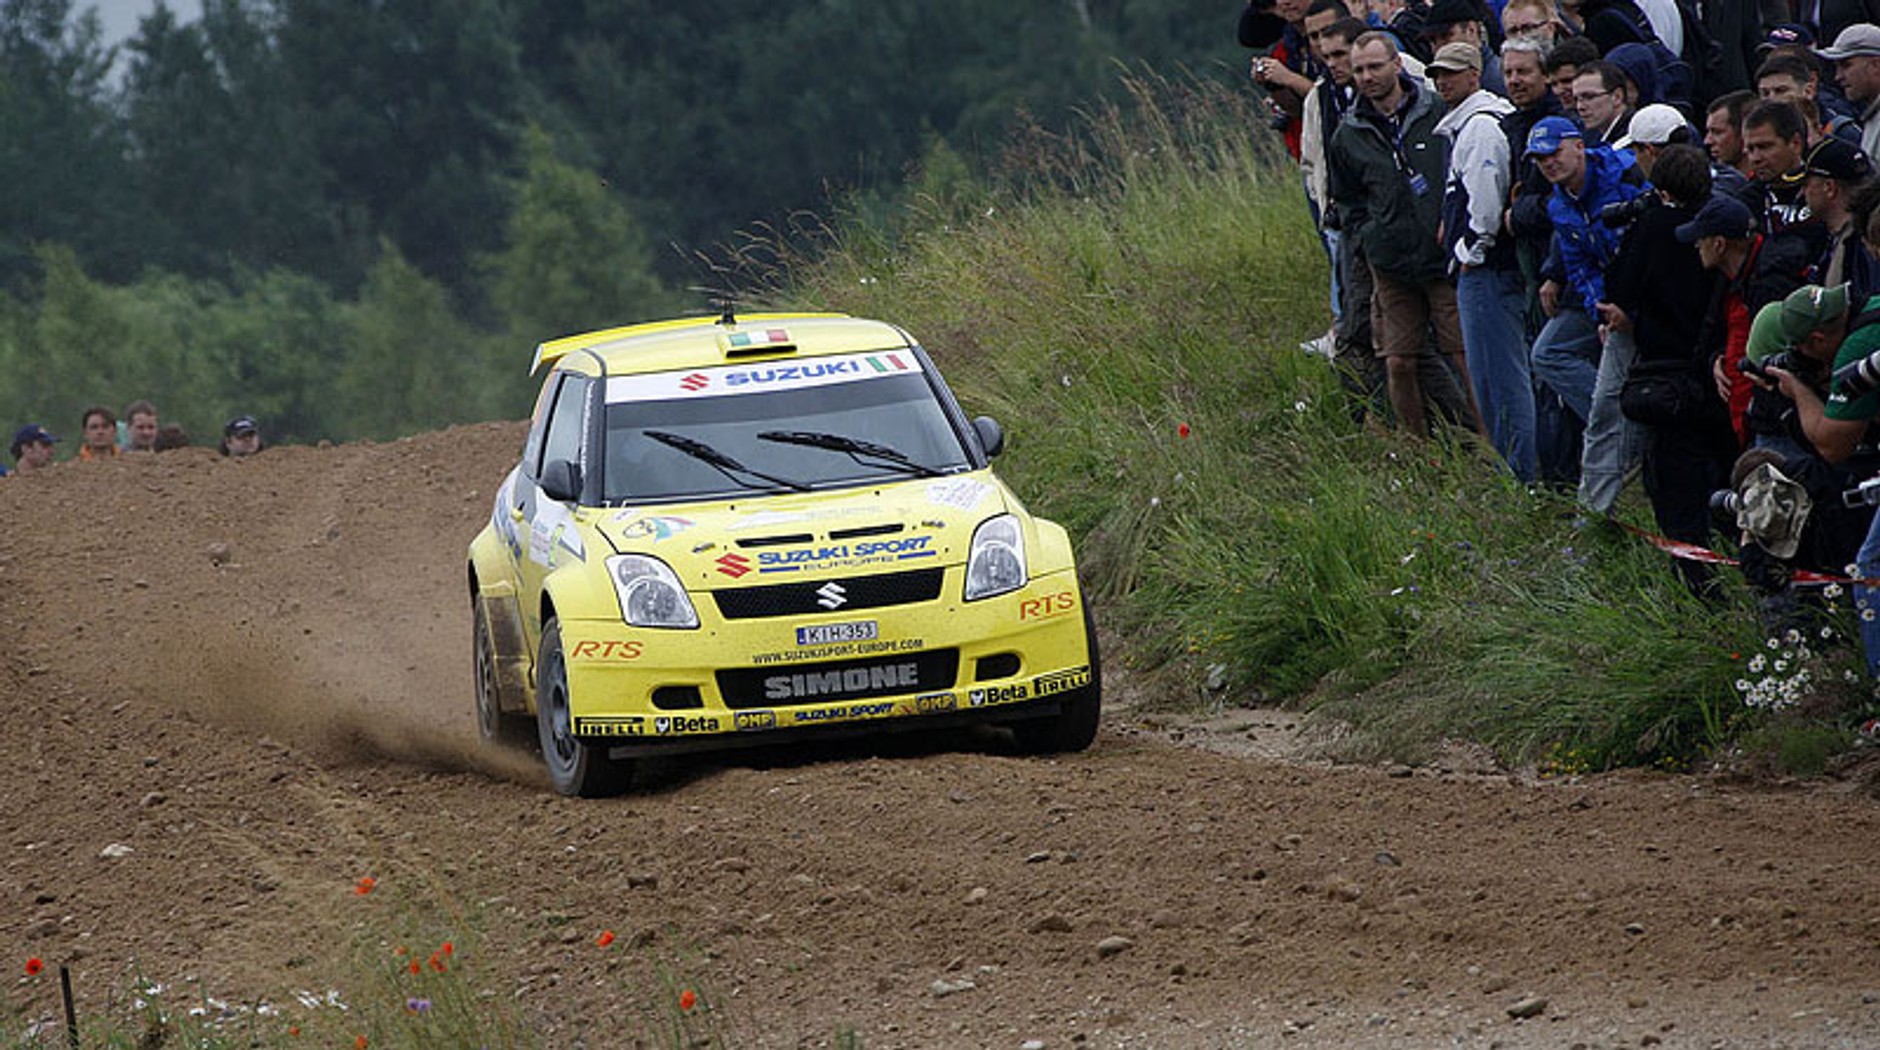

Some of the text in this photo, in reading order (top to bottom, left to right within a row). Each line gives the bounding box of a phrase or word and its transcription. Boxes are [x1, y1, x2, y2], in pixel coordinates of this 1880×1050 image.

[724, 360, 861, 387] SUZUKI
[758, 536, 932, 565] SUZUKI SPORT
[1020, 591, 1075, 620] RTS
[571, 641, 644, 659] RTS
[765, 663, 918, 699] SIMONE
[987, 684, 1028, 703] Beta
[672, 716, 719, 732] Beta
